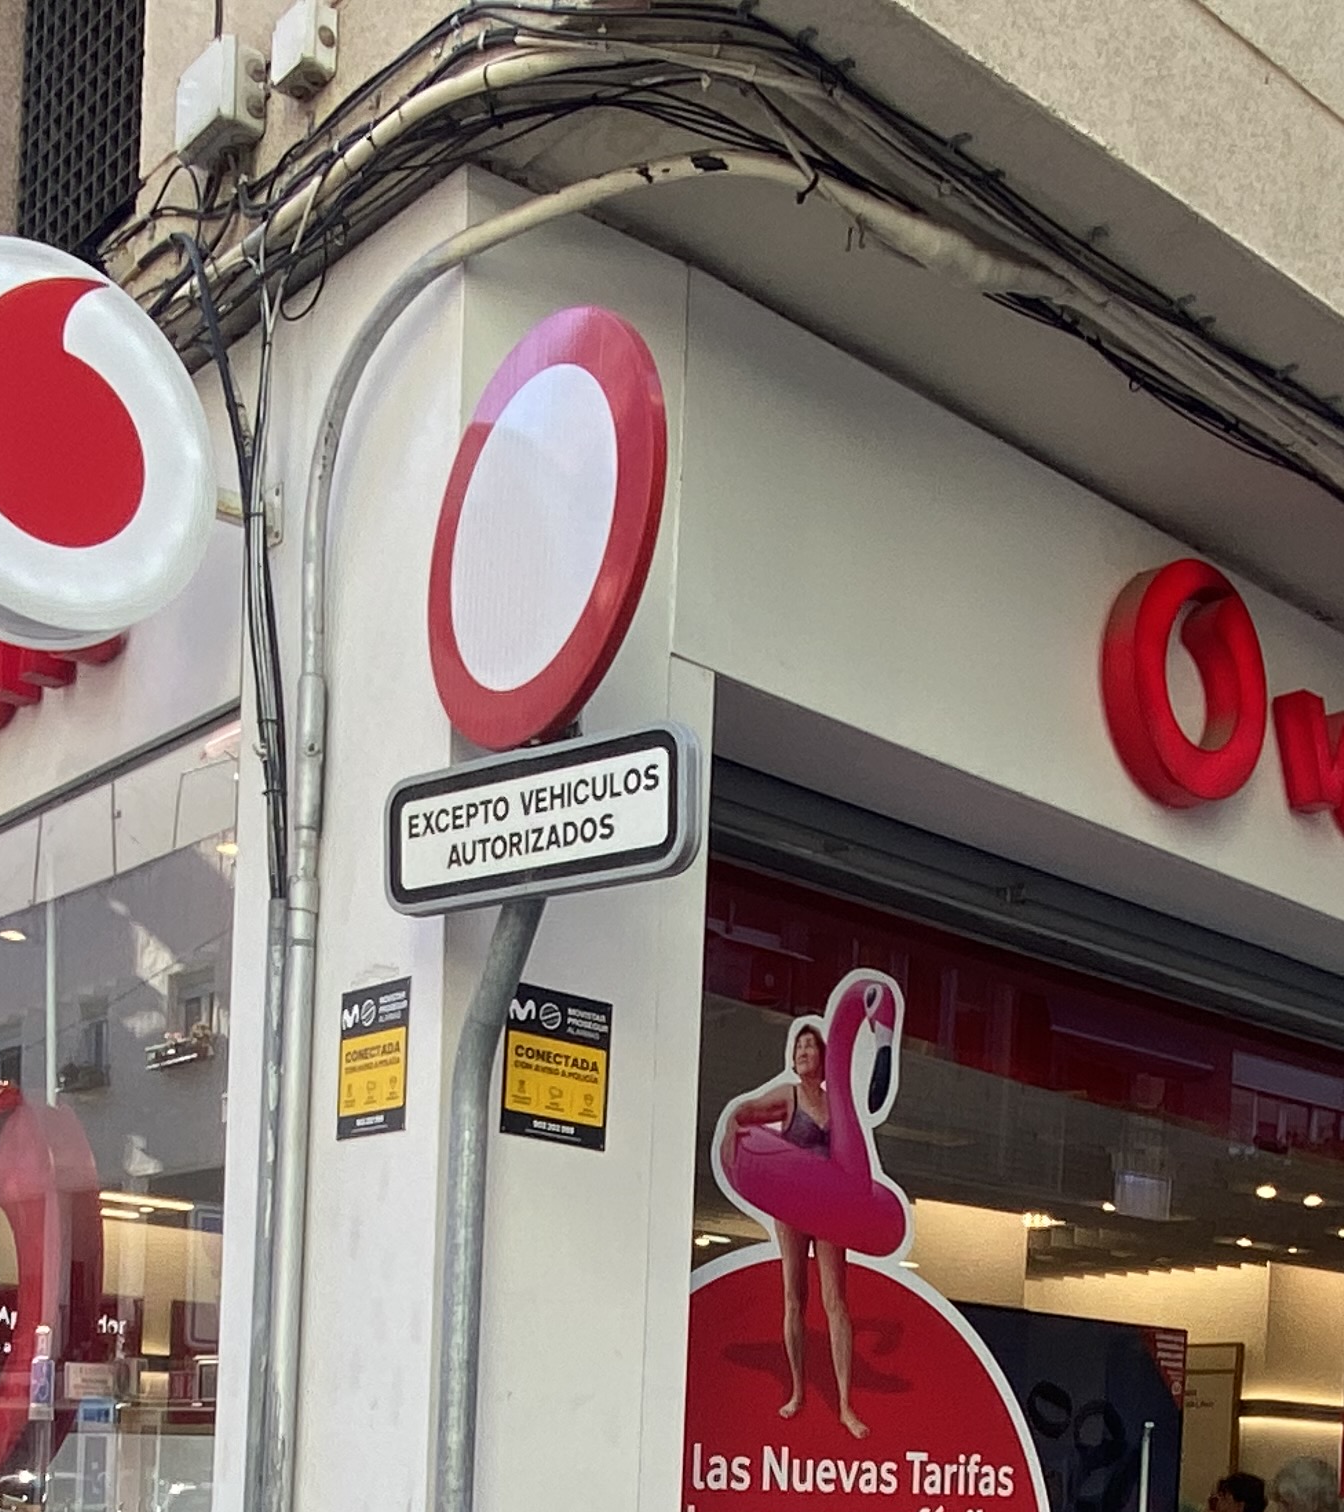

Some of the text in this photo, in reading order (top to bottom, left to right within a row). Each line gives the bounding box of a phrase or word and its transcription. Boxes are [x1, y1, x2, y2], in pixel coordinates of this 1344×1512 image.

[408, 763, 660, 839] EXCEPTO VEHICULOS
[447, 813, 616, 869] AUTORIZADOS
[345, 1040, 400, 1064] CONECTADA
[514, 1045, 600, 1075] CONECTADA
[692, 1443, 1014, 1498] las Nuevas Tarifas
